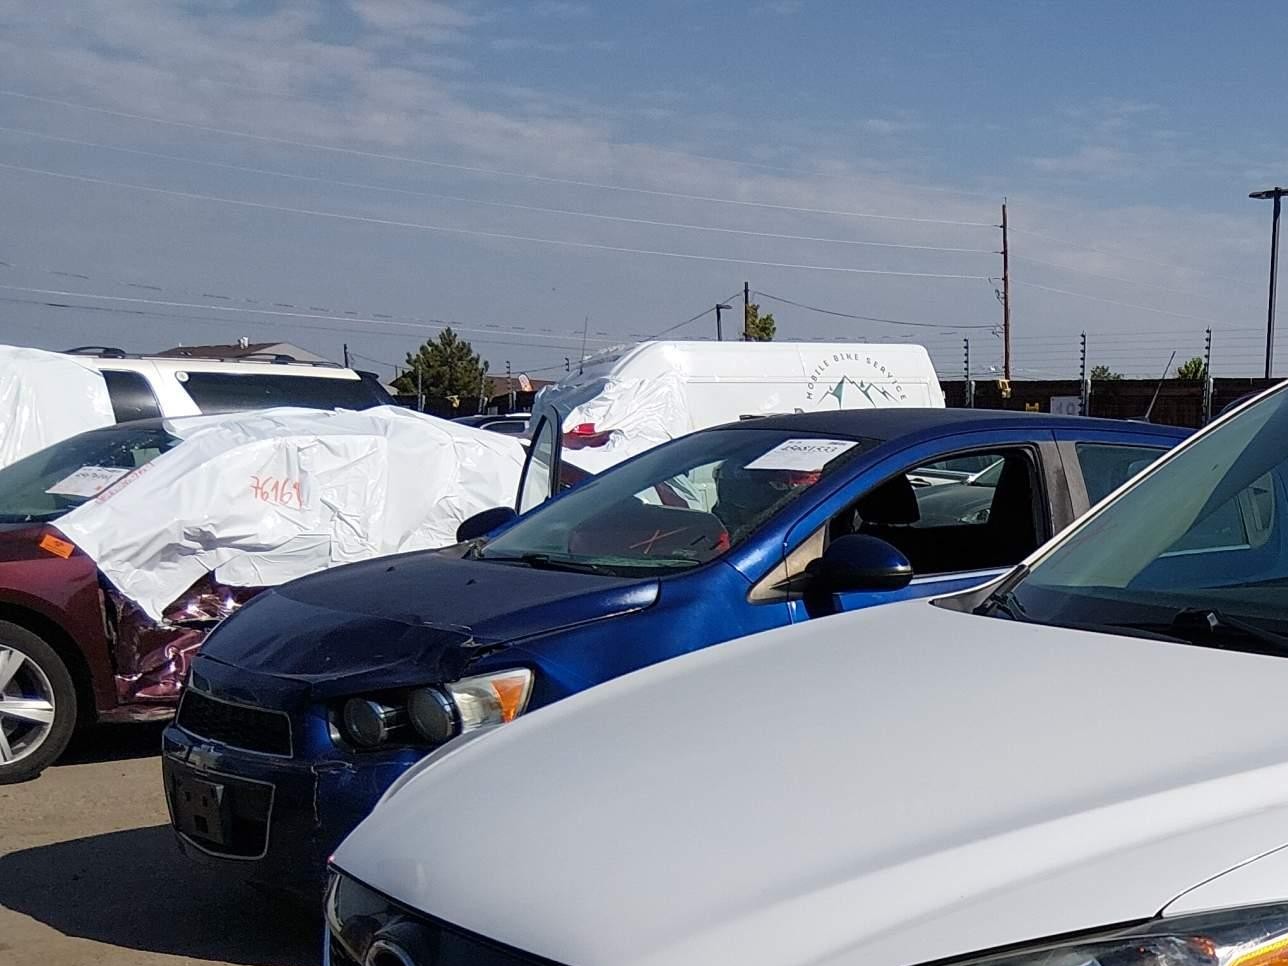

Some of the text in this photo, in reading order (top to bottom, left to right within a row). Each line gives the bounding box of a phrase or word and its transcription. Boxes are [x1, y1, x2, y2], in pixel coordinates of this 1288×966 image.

[807, 353, 906, 401] MOBILE BIKE SERVICE
